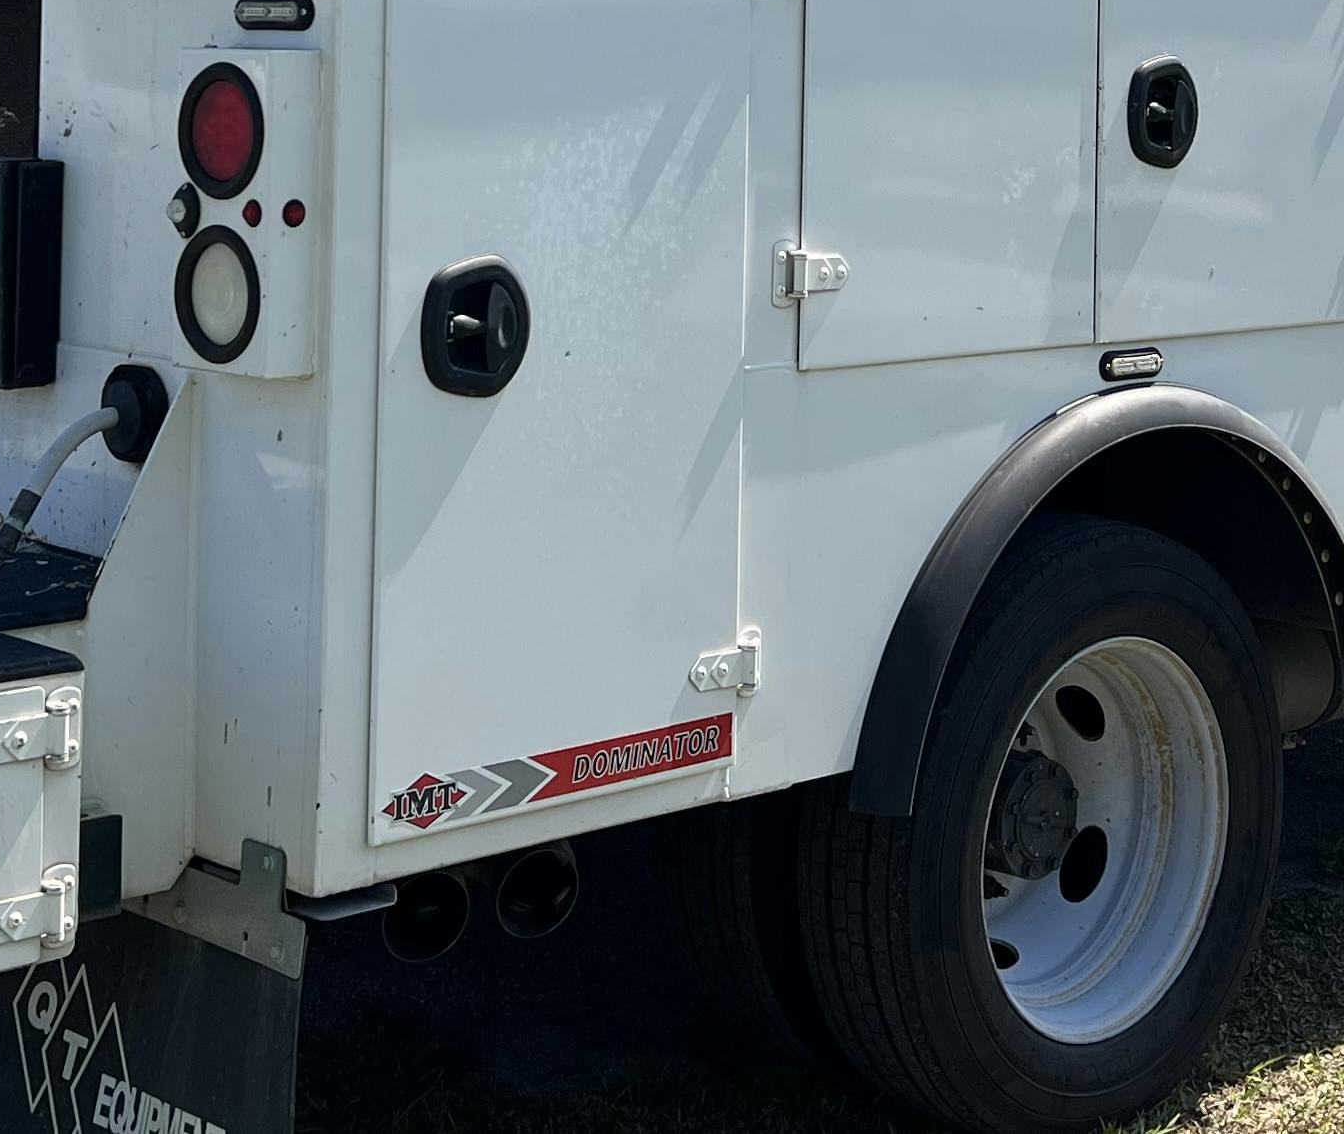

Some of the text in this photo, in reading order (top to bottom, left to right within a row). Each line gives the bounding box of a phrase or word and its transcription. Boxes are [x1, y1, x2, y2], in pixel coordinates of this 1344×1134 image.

[571, 723, 722, 785] DOMINATOR
[391, 780, 459, 822] IMT
[27, 980, 58, 1035] Q
[62, 1028, 90, 1081] T
[92, 1073, 226, 1134] EQUIPM
